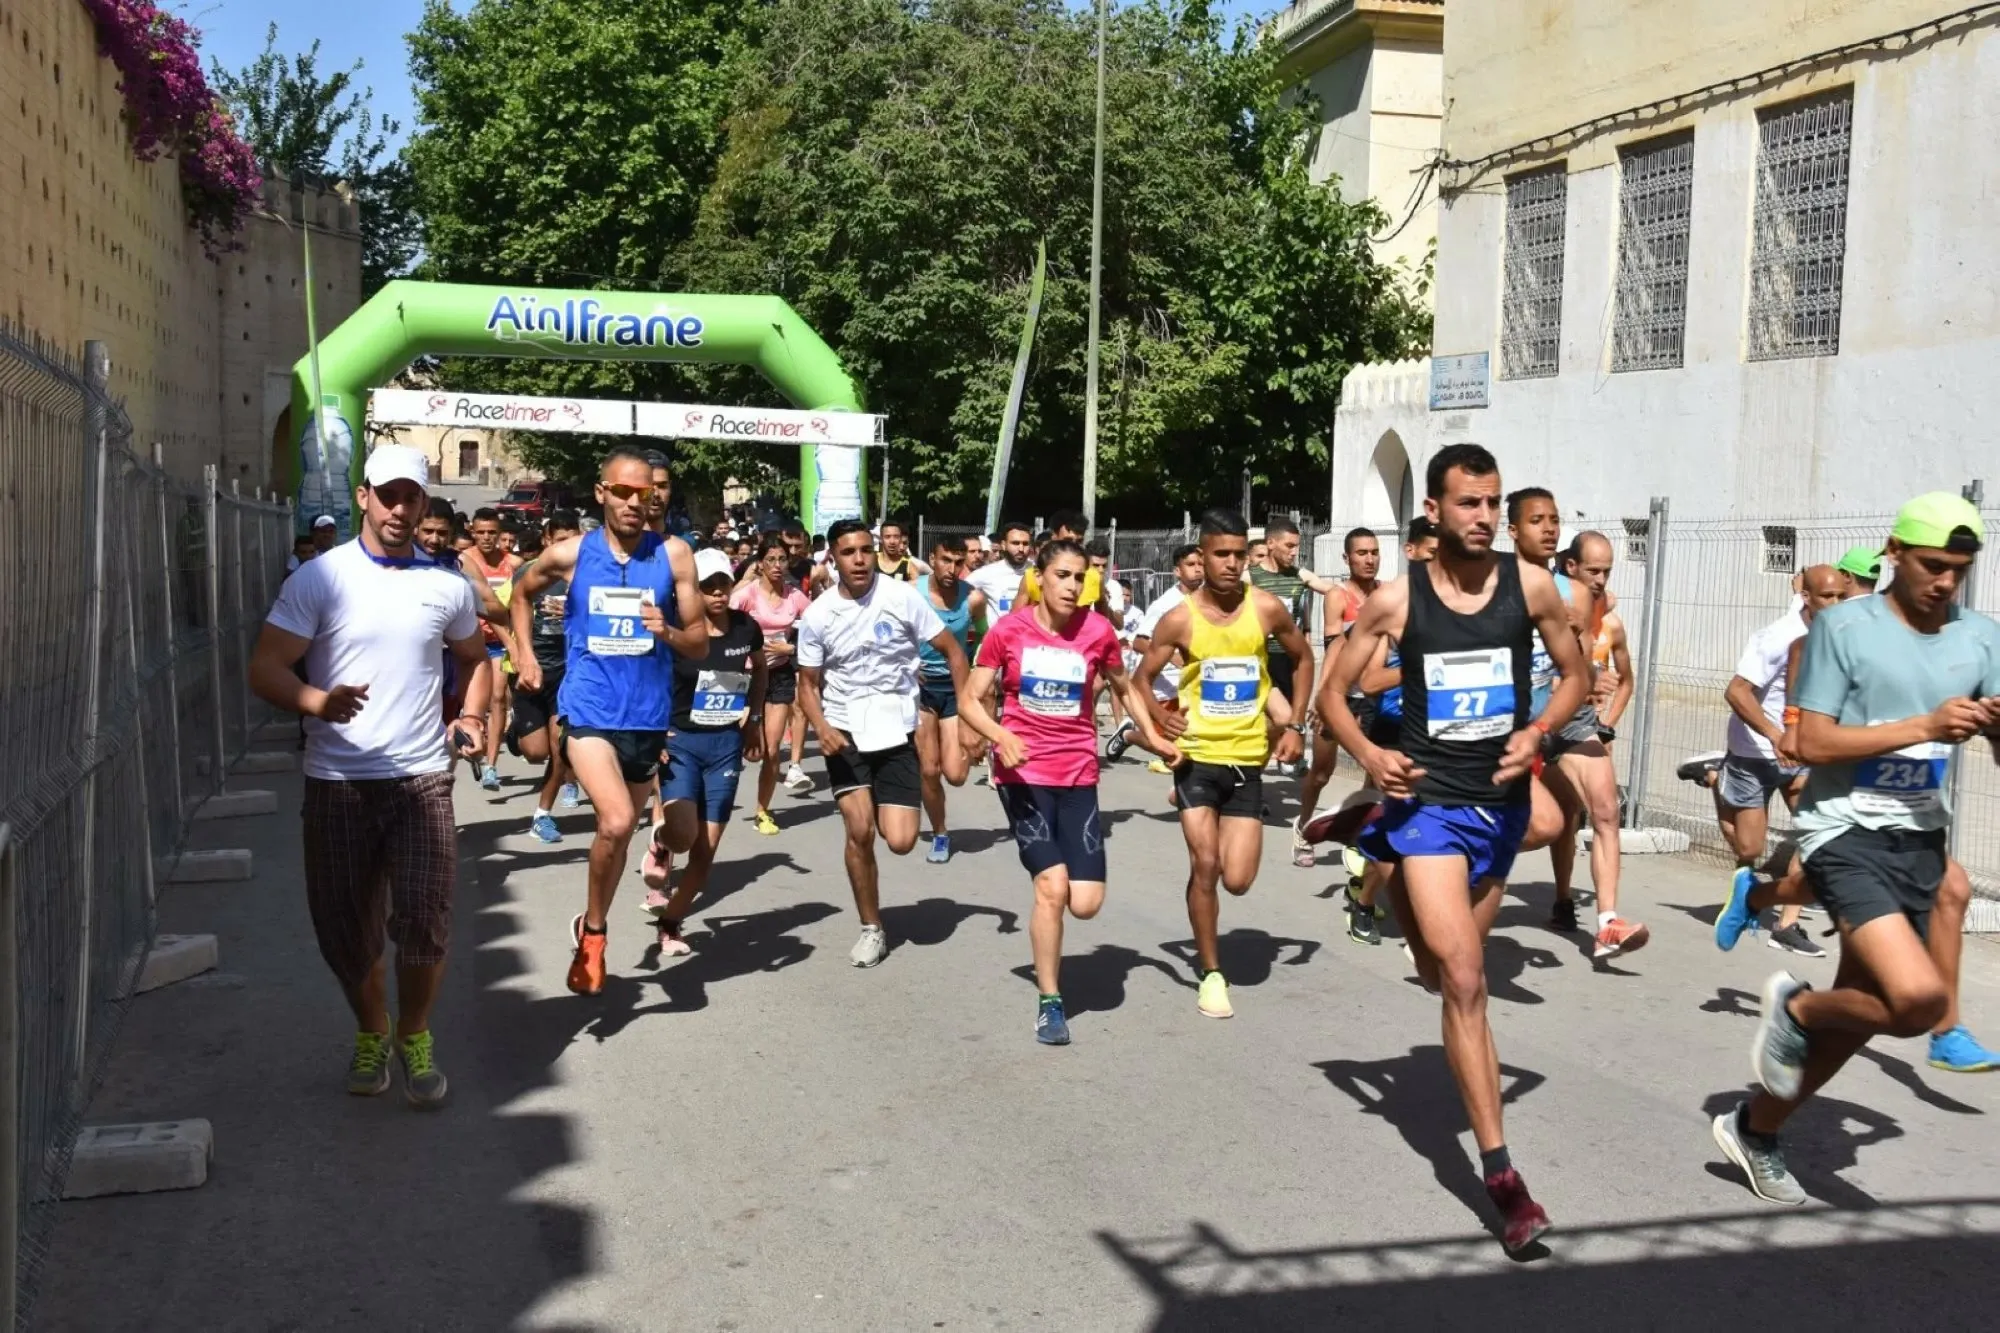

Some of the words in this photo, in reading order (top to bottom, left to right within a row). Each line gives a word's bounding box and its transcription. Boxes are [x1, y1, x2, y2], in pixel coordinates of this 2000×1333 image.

[454, 398, 556, 422] Racetimer
[710, 414, 804, 437] Racetimer
[608, 618, 634, 637] 78
[703, 694, 736, 710] 237
[1223, 683, 1237, 701] 8
[1453, 690, 1489, 717] 27
[1875, 762, 1930, 788] 234
